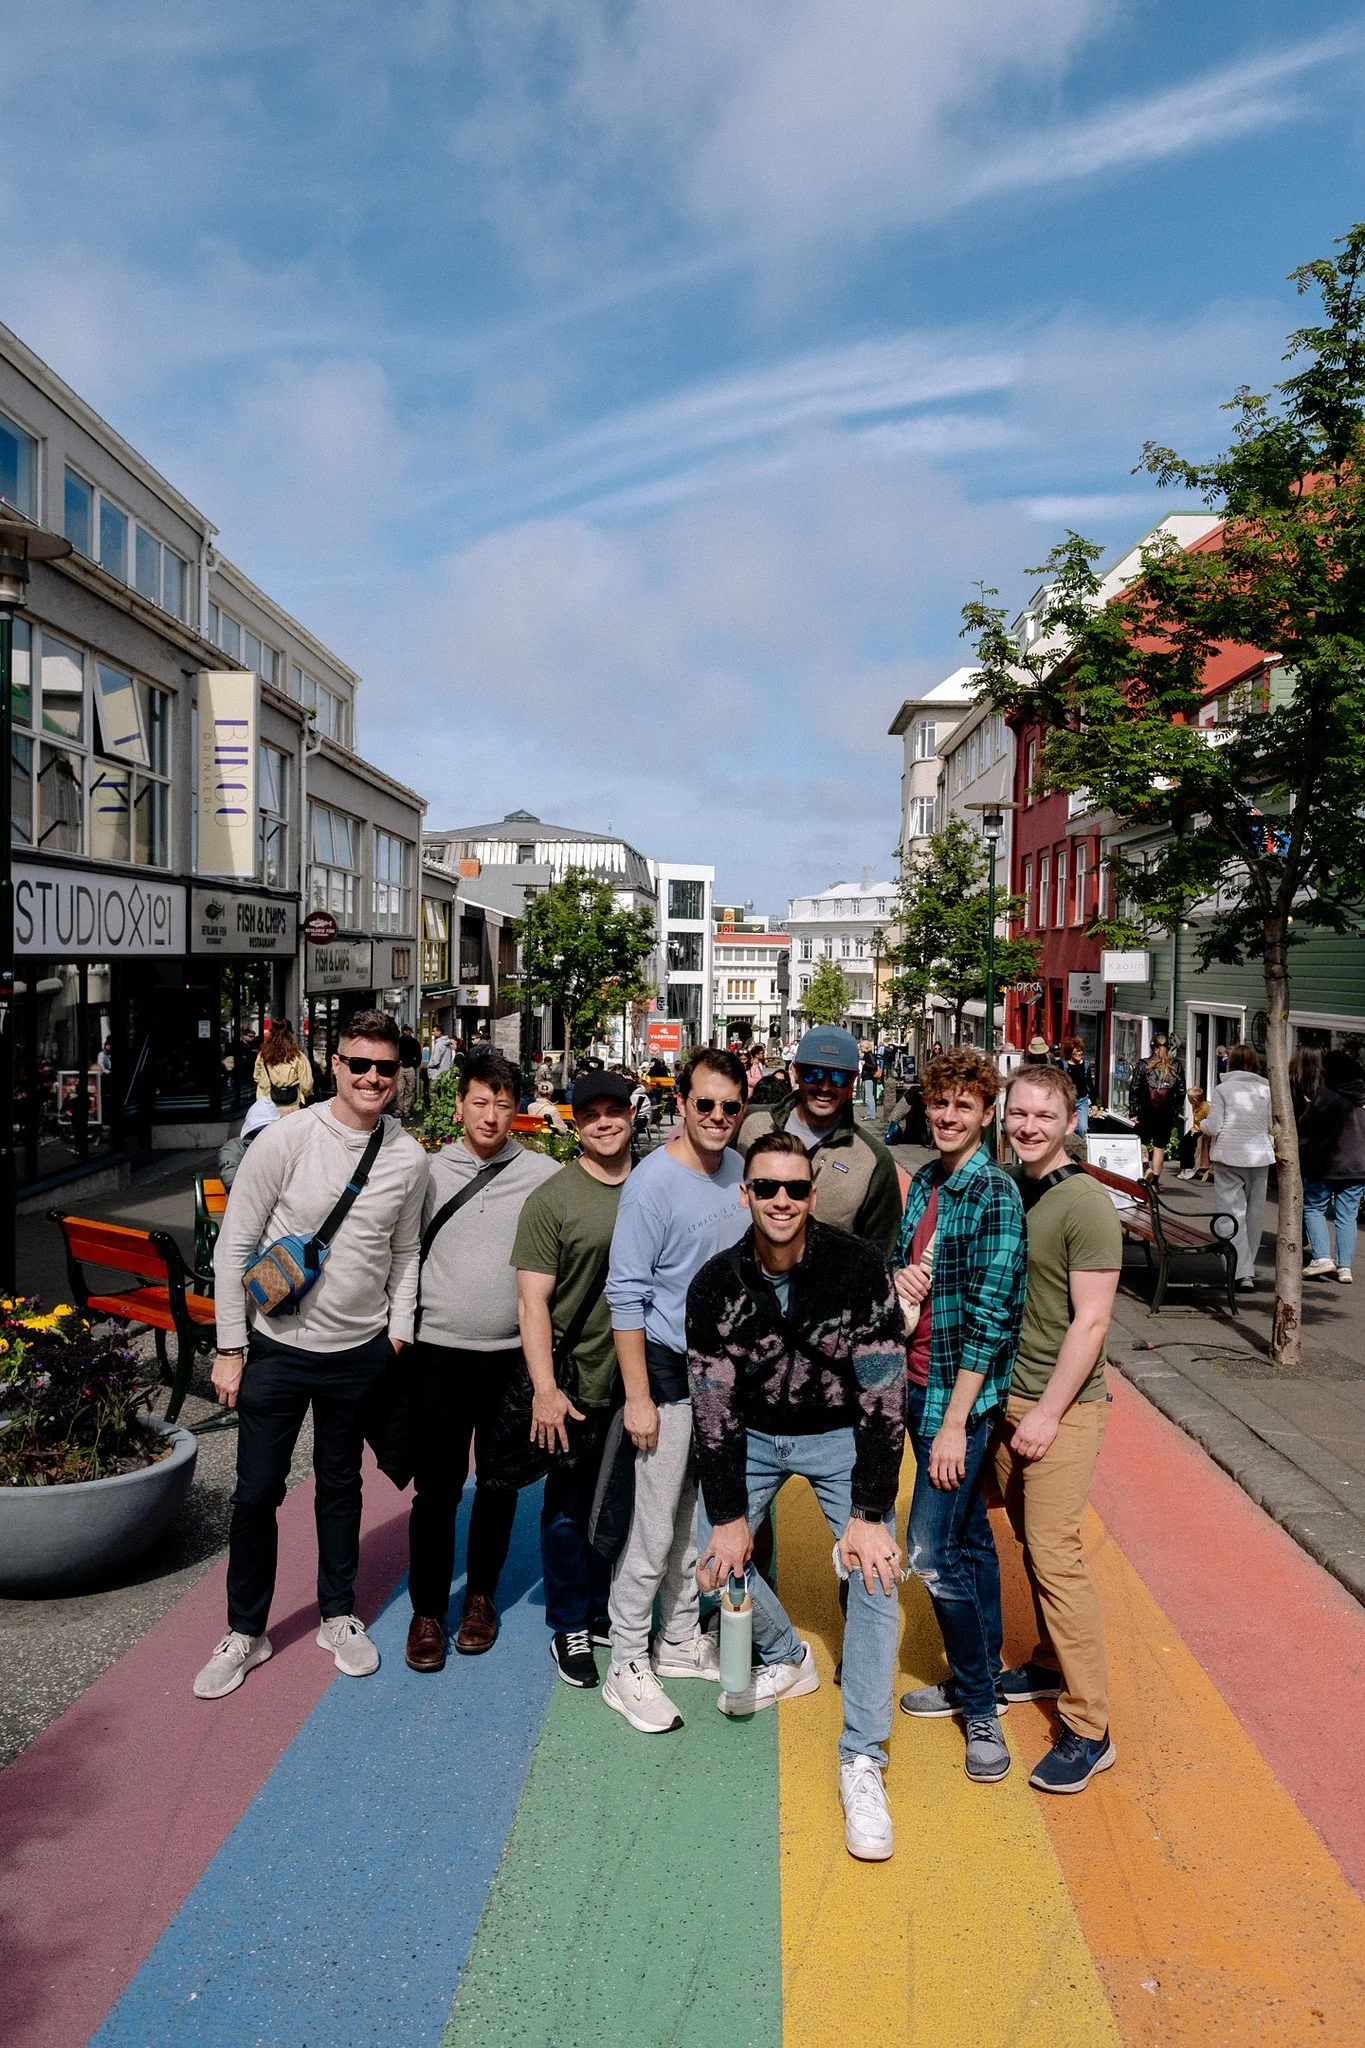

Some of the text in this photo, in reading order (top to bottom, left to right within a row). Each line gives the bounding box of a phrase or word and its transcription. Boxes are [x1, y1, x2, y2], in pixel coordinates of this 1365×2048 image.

[203, 733, 211, 815] DRINKERY
[214, 720, 248, 827] BINGO
[16, 880, 125, 946] STUDIO
[237, 903, 286, 935] FISH & CHIPS
[249, 936, 276, 948] RESTAURANT
[315, 948, 328, 973] FISH
[1108, 961, 1144, 971] Kaolin
